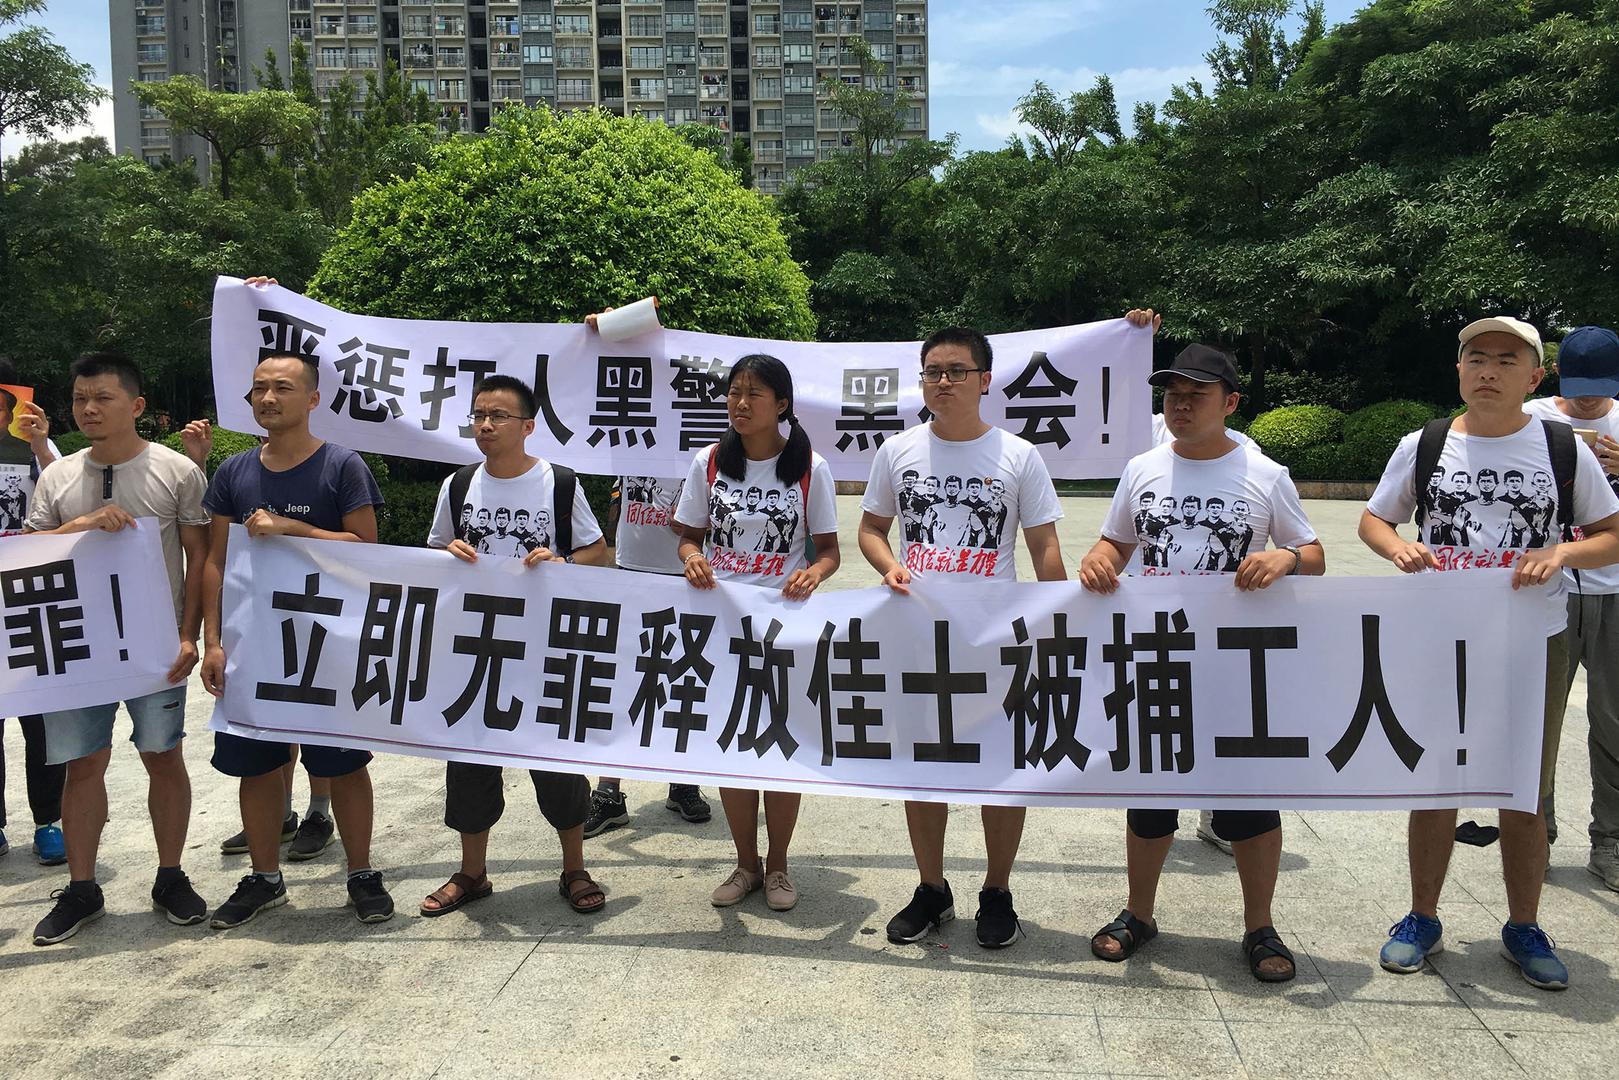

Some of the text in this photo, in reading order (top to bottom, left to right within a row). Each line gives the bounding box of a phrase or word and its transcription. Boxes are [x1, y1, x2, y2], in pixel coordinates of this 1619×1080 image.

[284, 503, 311, 515] Jeep
[0, 559, 129, 676] 罪！
[255, 572, 1467, 774] 立即无罪释放佳士被捕工人！
